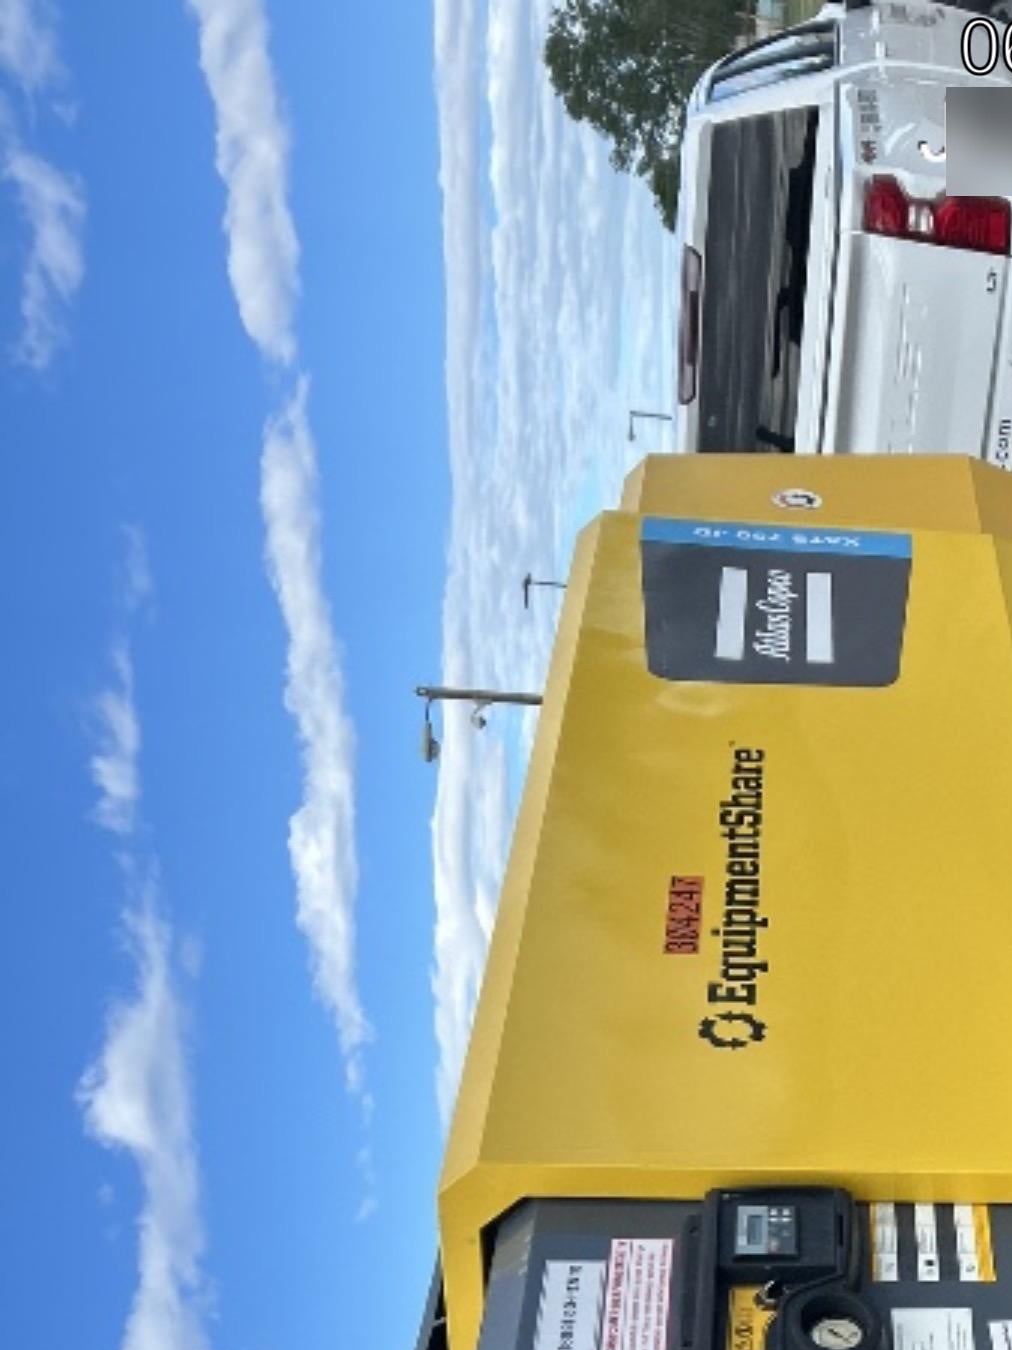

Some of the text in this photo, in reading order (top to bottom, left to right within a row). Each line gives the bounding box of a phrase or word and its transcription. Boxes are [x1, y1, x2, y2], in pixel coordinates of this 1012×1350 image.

[753, 569, 799, 663] Atlas Copco
[664, 875, 701, 954] 304247
[708, 748, 769, 1006] EquipmentShare
